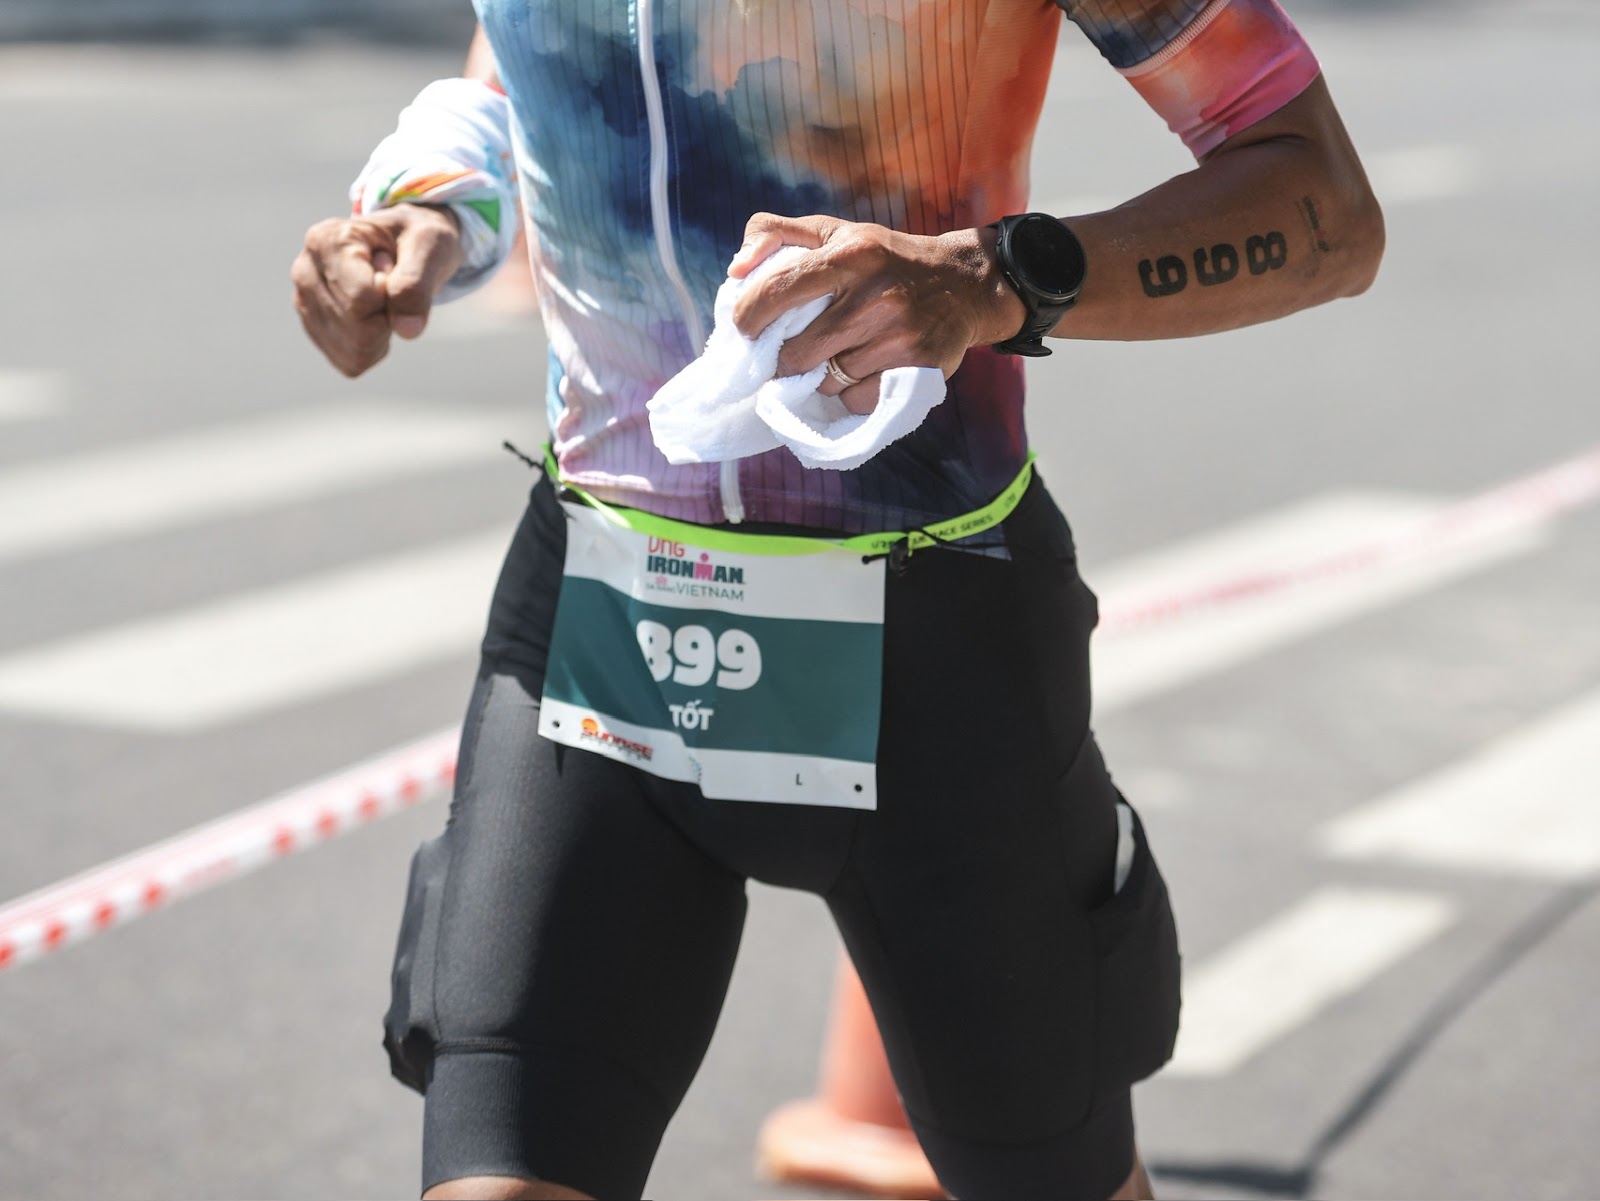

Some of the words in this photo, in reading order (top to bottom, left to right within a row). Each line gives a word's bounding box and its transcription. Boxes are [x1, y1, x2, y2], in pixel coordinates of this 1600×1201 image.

[647, 553, 744, 585] IRONMAN
[676, 582, 744, 602] VIETNAM
[636, 620, 762, 690] 899
[669, 700, 714, 731] TỐT
